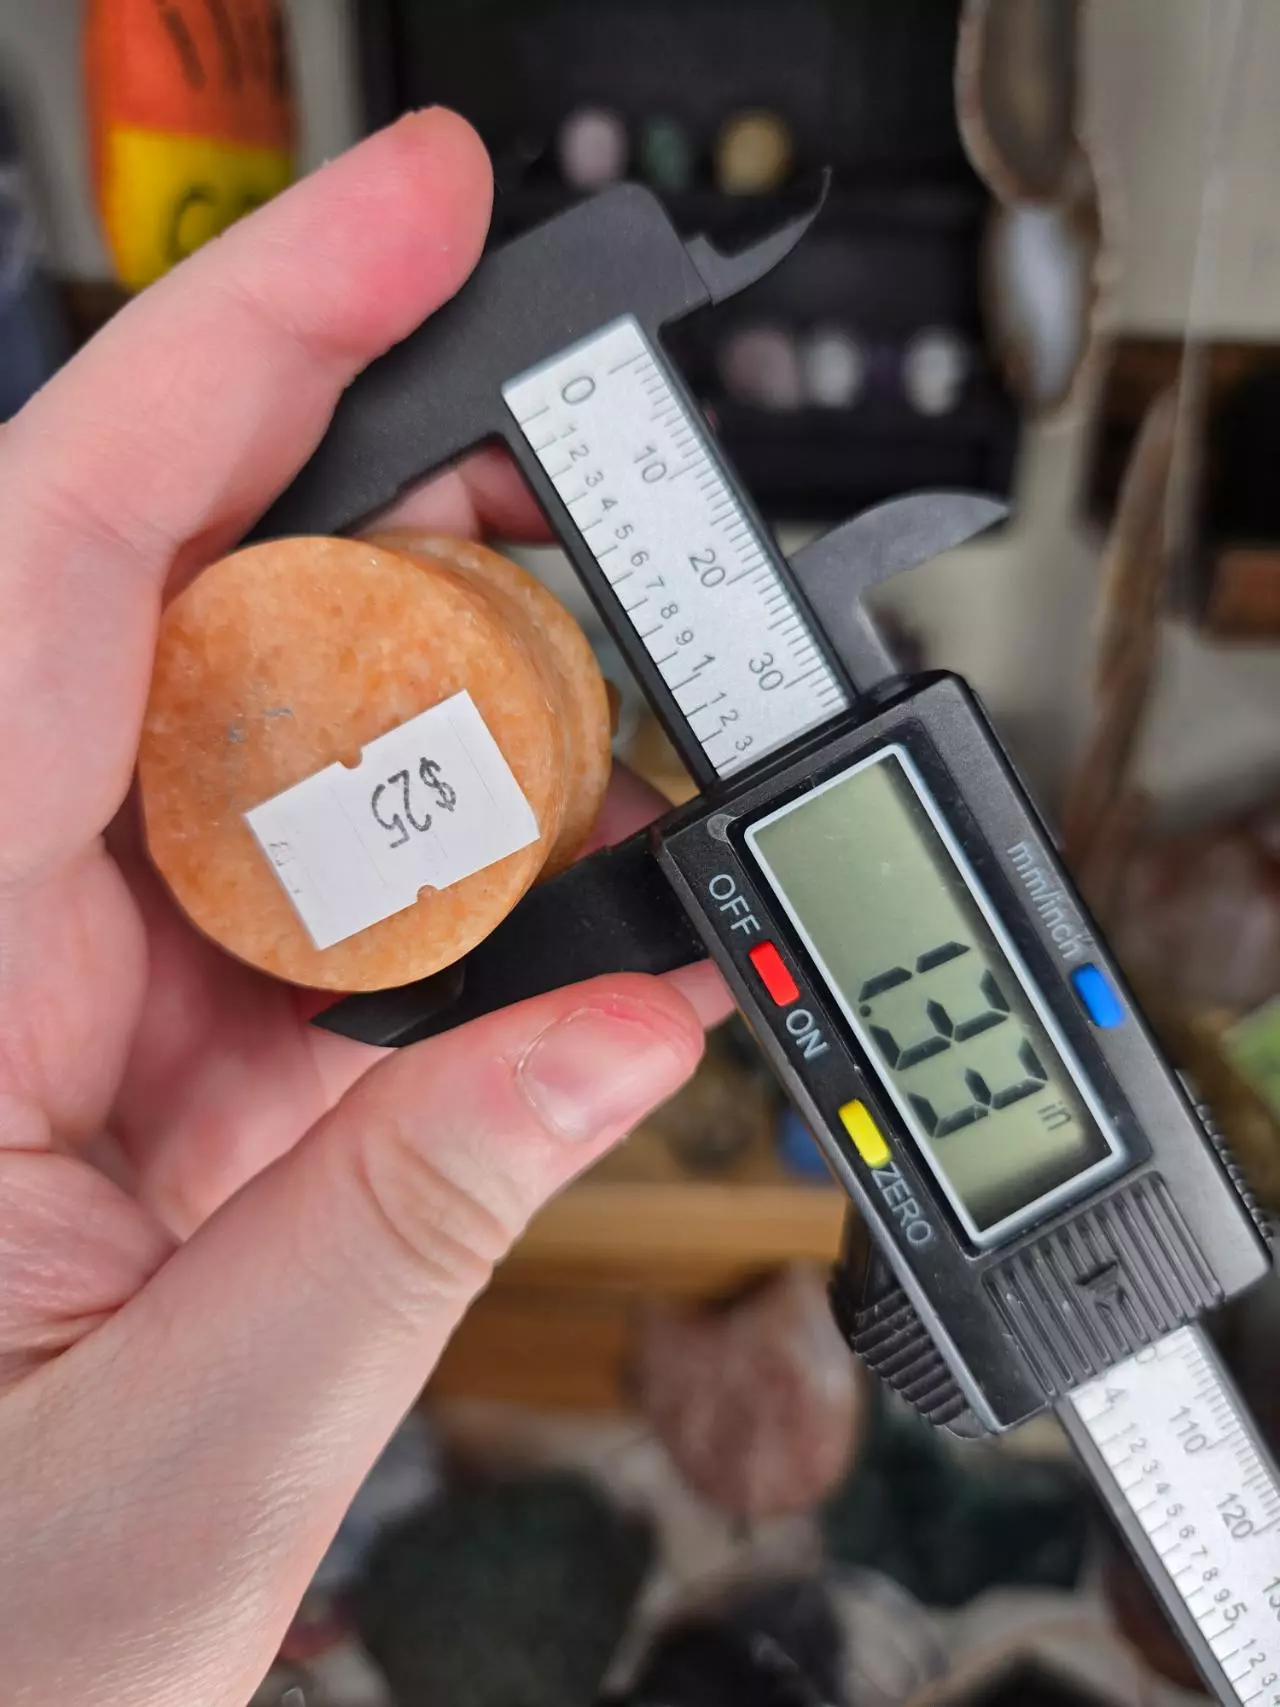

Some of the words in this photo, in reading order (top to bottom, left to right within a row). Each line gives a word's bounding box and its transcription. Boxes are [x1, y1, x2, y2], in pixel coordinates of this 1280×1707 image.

[560, 424, 577, 439] 1
[568, 444, 590, 462] 2
[585, 471, 604, 488] 3
[601, 498, 618, 513] 4
[561, 376, 596, 405] 0
[632, 445, 667, 482] 10
[688, 548, 726, 588] 20
[749, 652, 784, 691] 30
[614, 524, 634, 540] 5
[630, 550, 650, 567] 6
[645, 575, 665, 590] 7
[660, 603, 679, 619] 8
[675, 630, 694, 646] 9
[692, 654, 716, 673] 1
[710, 692, 727, 704] 1
[719, 709, 739, 727] 2
[735, 735, 754, 752] 3
[371, 756, 456, 849] $25
[708, 874, 761, 935] OFF
[1007, 841, 1082, 959] mm/inch
[786, 1008, 829, 1060] ON
[858, 941, 1048, 1139] 1.33
[1037, 1100, 1072, 1132] in
[871, 1161, 932, 1243] ZERO
[1104, 1387, 1129, 1406] 4
[1121, 1421, 1138, 1435] 1
[1129, 1437, 1148, 1454] 2
[1142, 1459, 1160, 1474] 3
[1168, 1405, 1207, 1453] 110
[1216, 1492, 1254, 1540] 120
[1155, 1482, 1172, 1496] 4
[1166, 1503, 1186, 1517] 5
[1179, 1524, 1197, 1539] 6
[1189, 1544, 1208, 1557] 7
[1202, 1566, 1219, 1582] 8
[1213, 1588, 1231, 1603] 9
[1223, 1601, 1248, 1621] 5
[1242, 1638, 1258, 1651] 1
[1249, 1652, 1267, 1668] 2
[1261, 1672, 1278, 1688] 3
